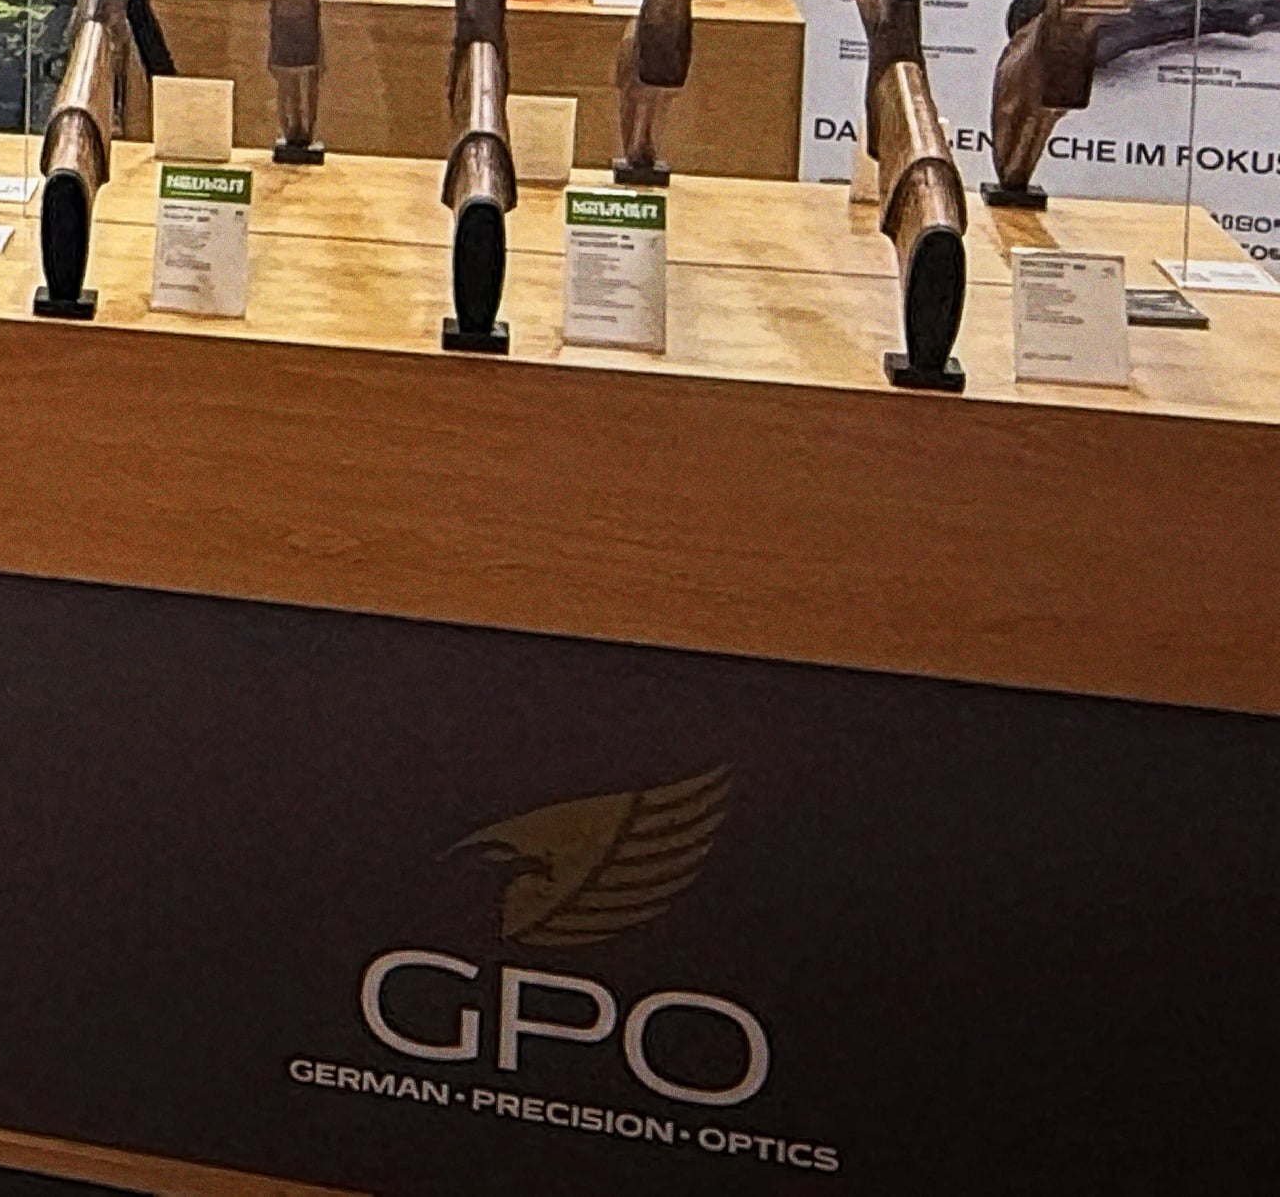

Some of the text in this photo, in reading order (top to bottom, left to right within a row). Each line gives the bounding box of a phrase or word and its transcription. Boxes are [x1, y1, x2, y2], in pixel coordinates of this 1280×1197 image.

[1125, 140, 1166, 167] IM
[1176, 144, 1280, 175] FOKU
[360, 949, 771, 1107] GPO
[289, 1058, 841, 1173] GERMAN PRECISION OPTICS
